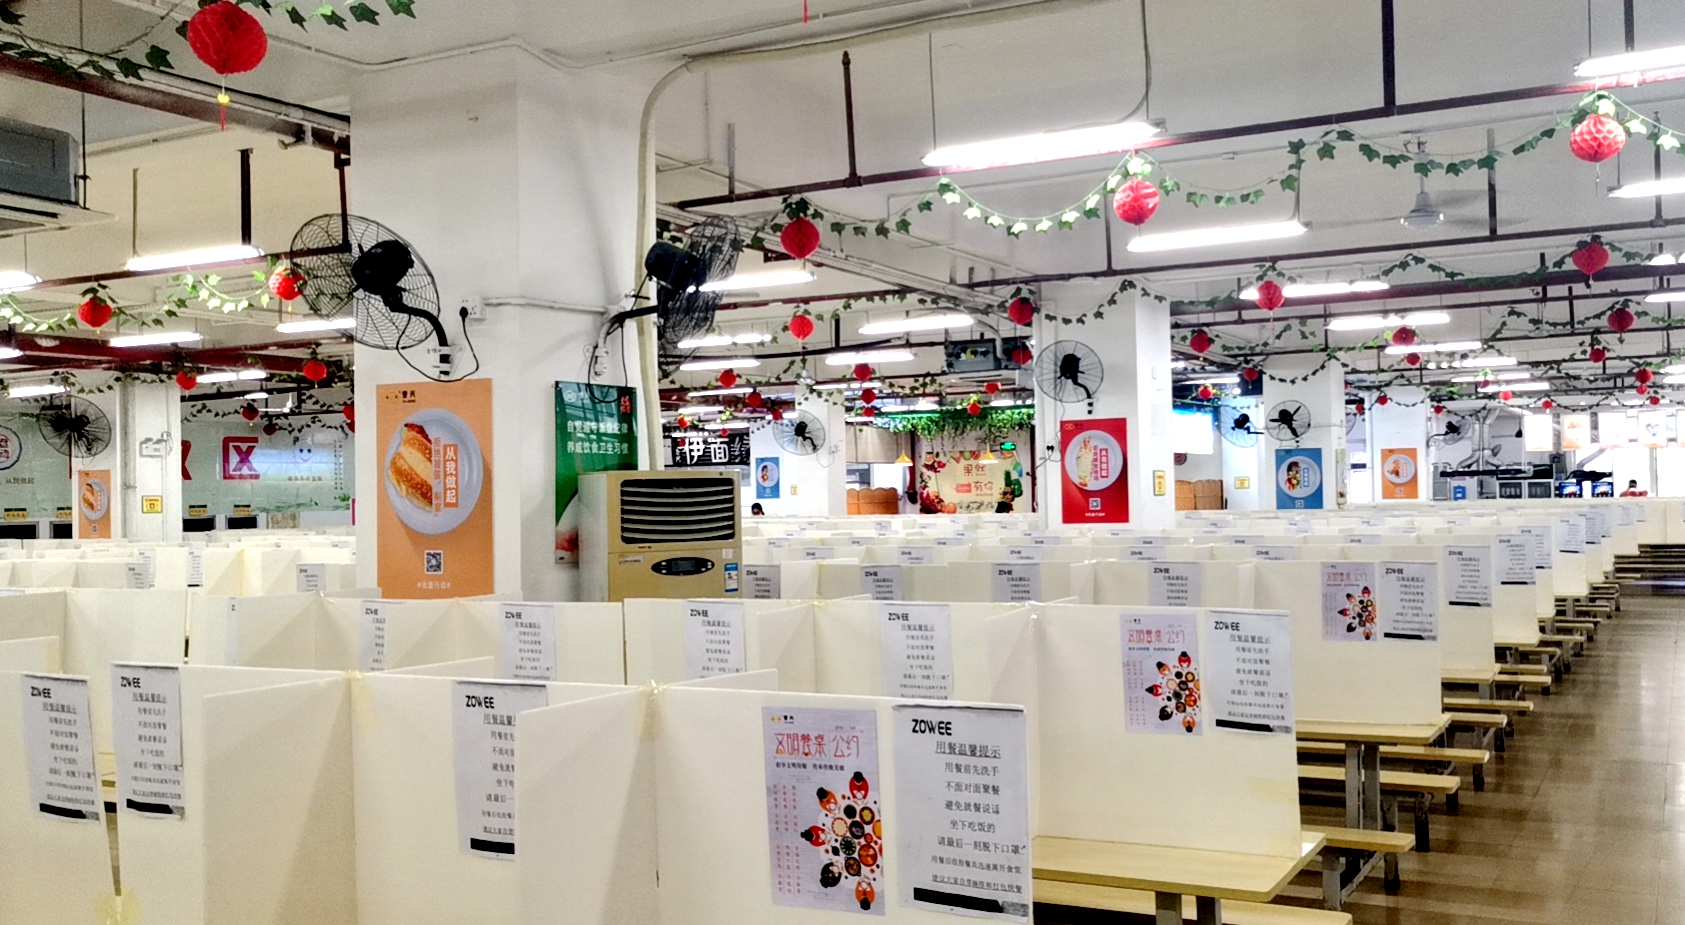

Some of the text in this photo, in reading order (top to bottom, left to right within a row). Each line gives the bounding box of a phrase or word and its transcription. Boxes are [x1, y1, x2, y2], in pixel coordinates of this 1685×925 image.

[445, 446, 457, 503] 从我做起
[1214, 620, 1241, 631] ZOWEE
[465, 695, 495, 709] ZOWEE
[483, 713, 516, 727] 用餐温馨
[911, 718, 953, 736] ZOWEE
[774, 732, 860, 759] 文明餐桌 公约
[935, 740, 1002, 759] 用餐温馨提示
[944, 762, 1001, 777] 用餐前先洗手
[944, 780, 1001, 796] 不面对面聚餐
[944, 799, 1001, 816] 避免就餐说话
[949, 819, 997, 834] 坐下吃饭的
